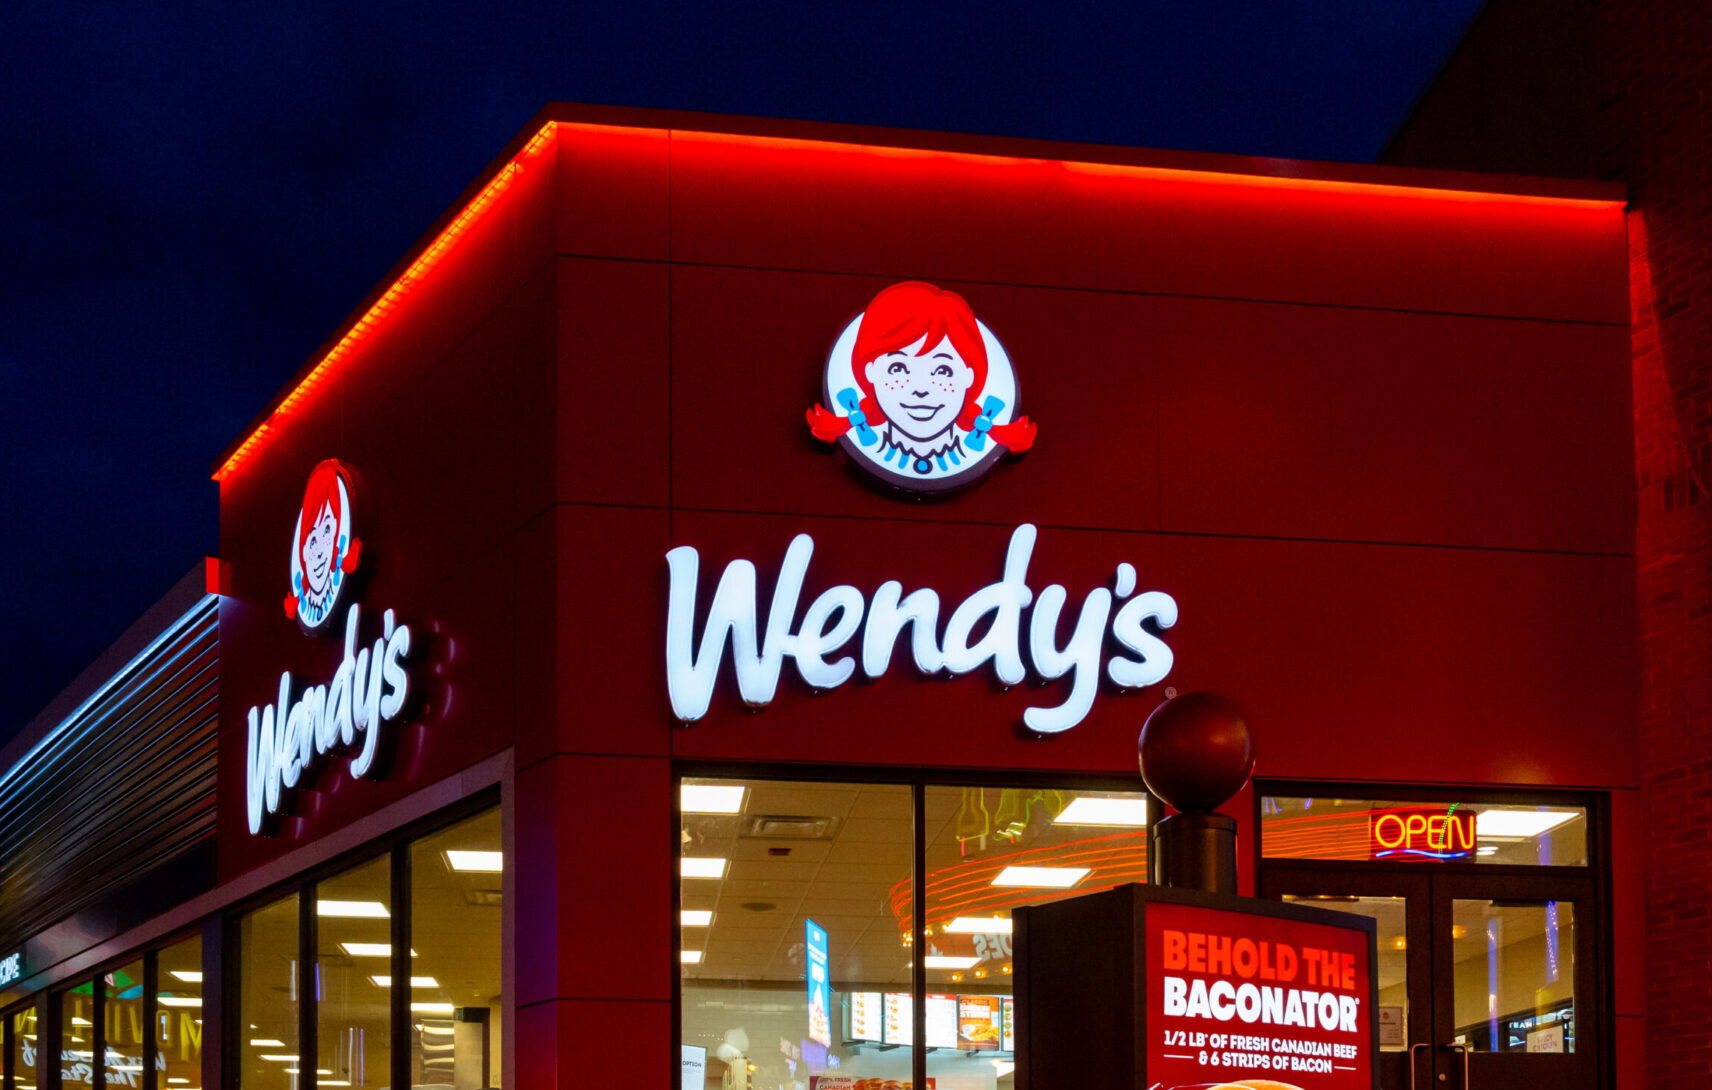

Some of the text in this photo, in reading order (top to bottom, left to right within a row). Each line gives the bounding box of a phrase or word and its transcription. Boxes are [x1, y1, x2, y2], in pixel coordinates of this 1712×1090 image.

[665, 522, 1179, 734] Wendy's
[247, 603, 412, 835] Wendy's
[1375, 813, 1475, 850] OPEN
[1163, 929, 1355, 991] BEHOLD THE
[1164, 1030, 1186, 1046] 1/2
[1209, 1033, 1228, 1049] OF
[1230, 1034, 1270, 1052] FRESH
[1271, 1037, 1332, 1057] CANADIAN
[1333, 1043, 1358, 1059] BEEF
[1199, 1050, 1333, 1074] & 6 STRIPS OF BACON
